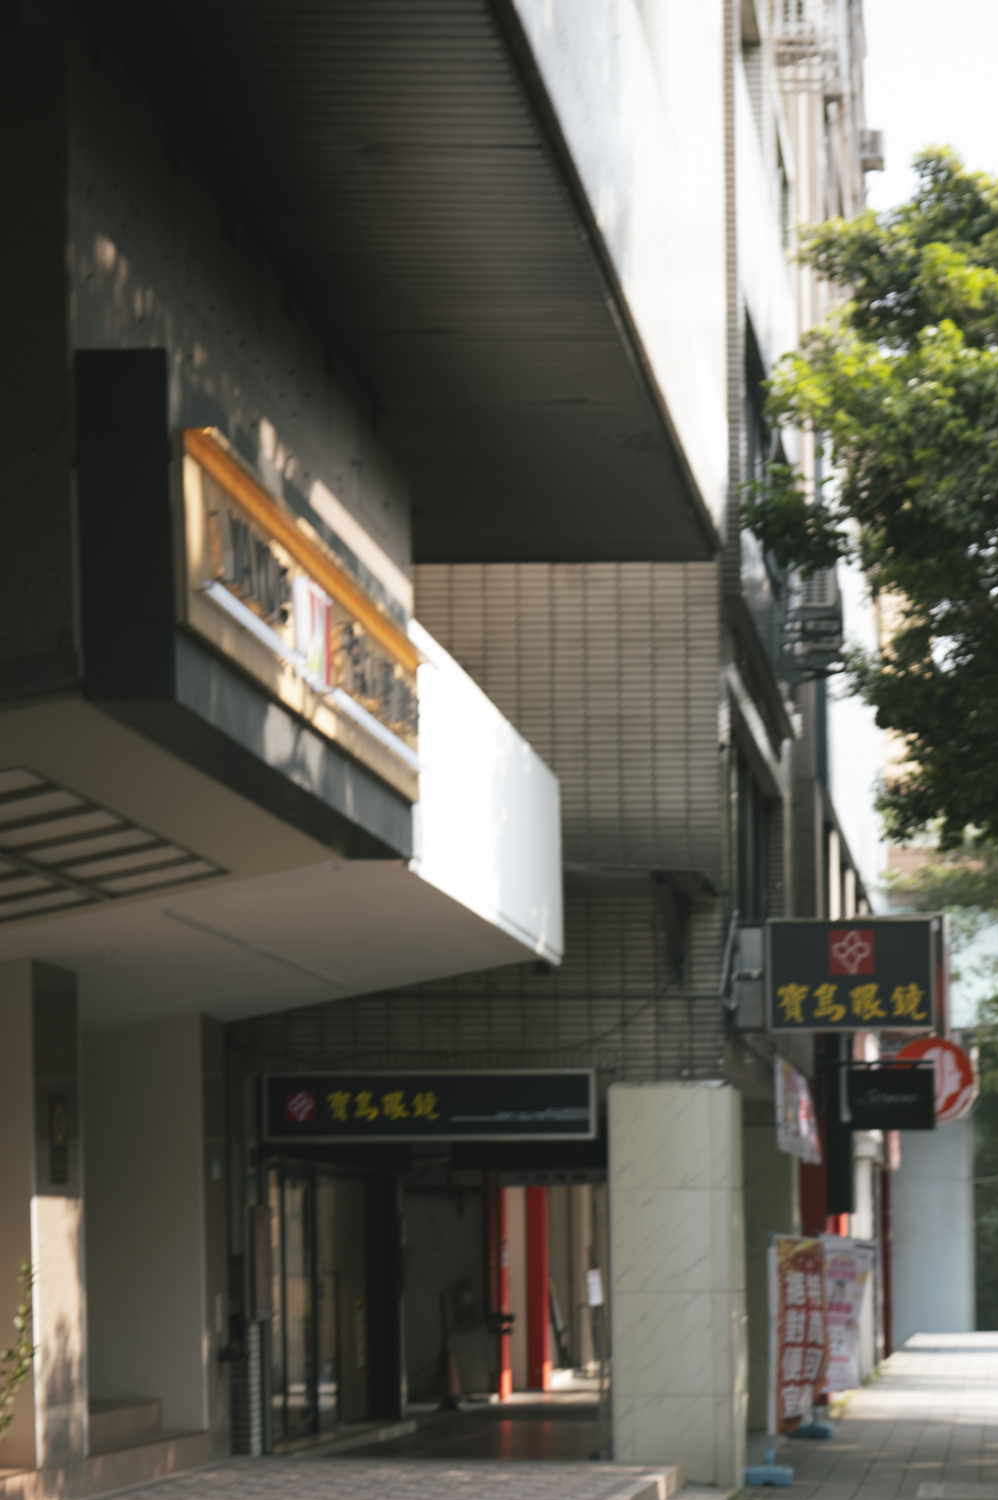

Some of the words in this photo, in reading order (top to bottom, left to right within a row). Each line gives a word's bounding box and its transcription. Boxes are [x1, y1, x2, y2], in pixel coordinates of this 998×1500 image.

[776, 982, 928, 1024] 寶島眼鏡
[327, 1090, 440, 1122] 寶島眼鏡
